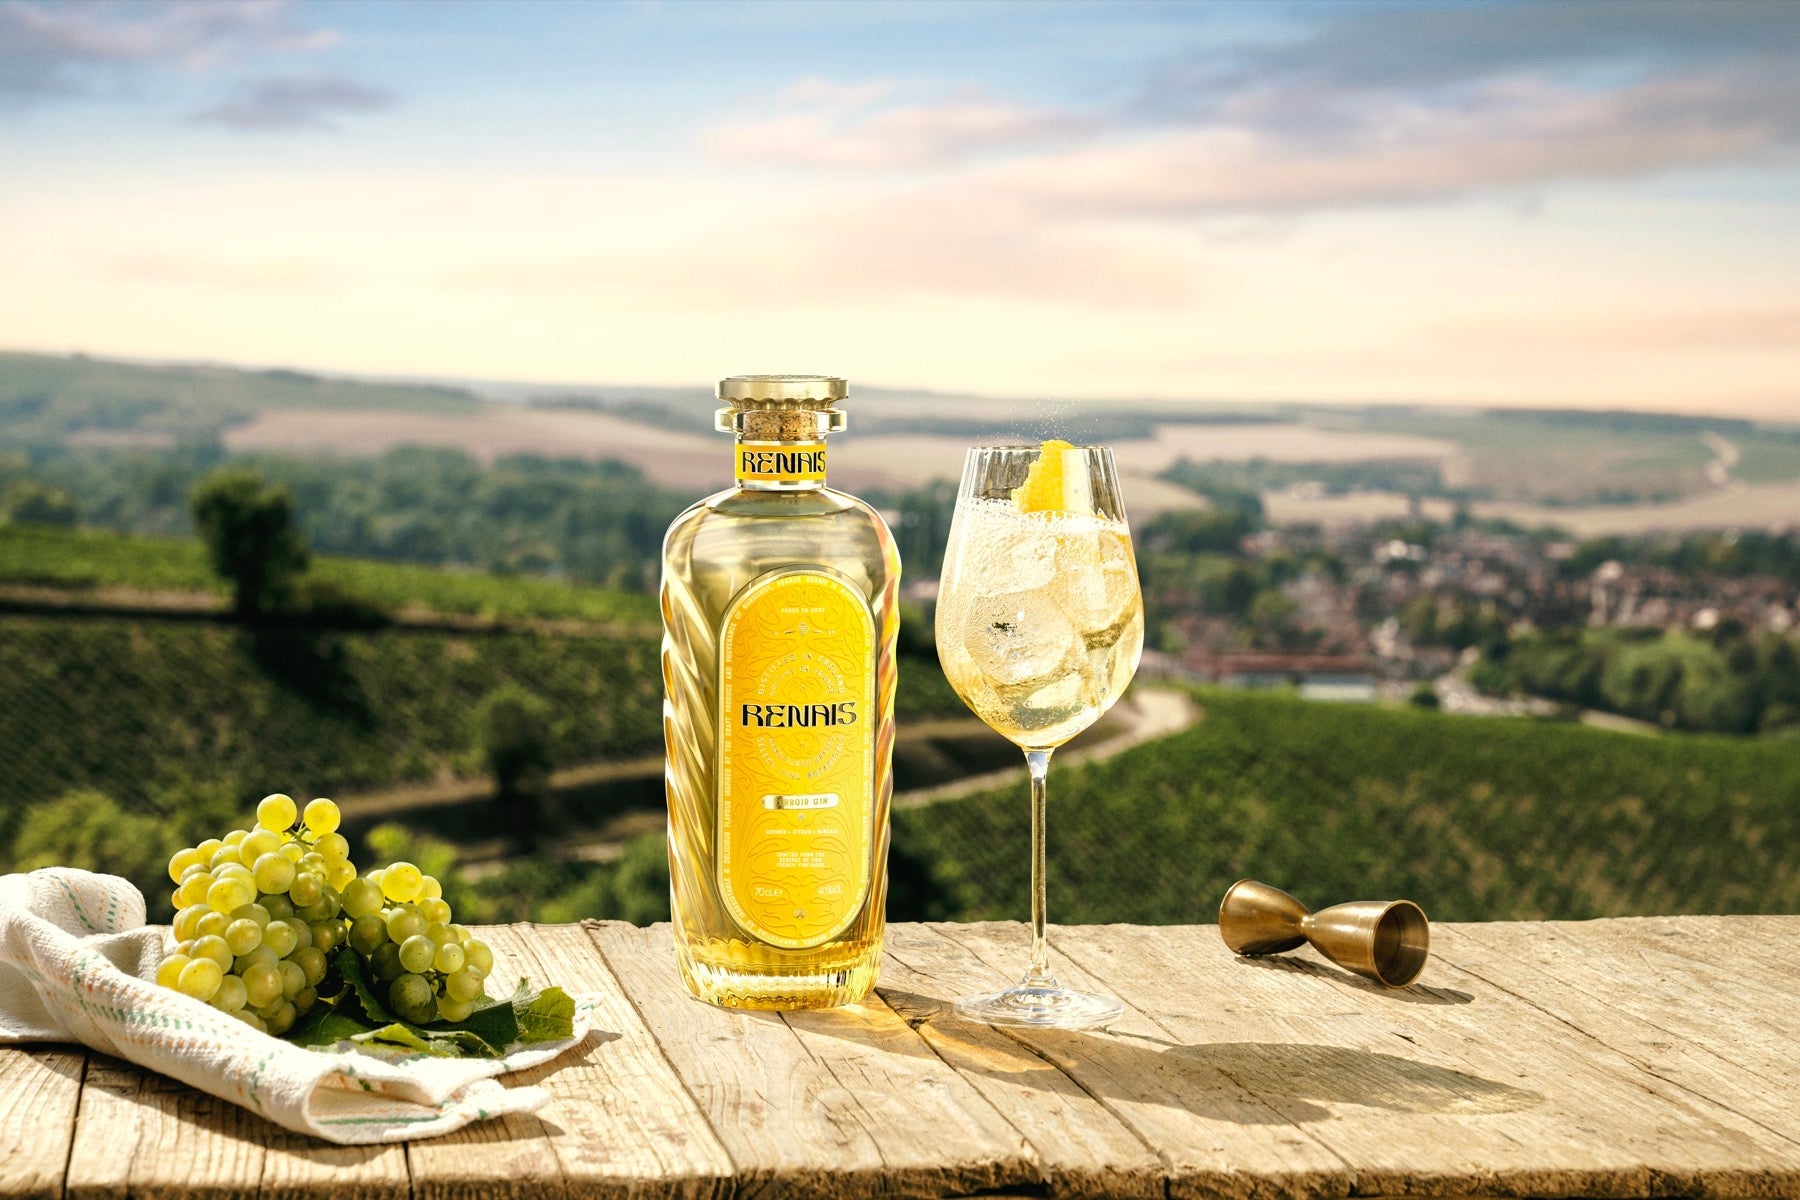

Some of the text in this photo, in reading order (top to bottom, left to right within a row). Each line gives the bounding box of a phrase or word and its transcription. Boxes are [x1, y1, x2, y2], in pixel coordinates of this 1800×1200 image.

[742, 451, 826, 474] RENAIS
[742, 701, 857, 728] RENAIS
[813, 797, 828, 805] GIN
